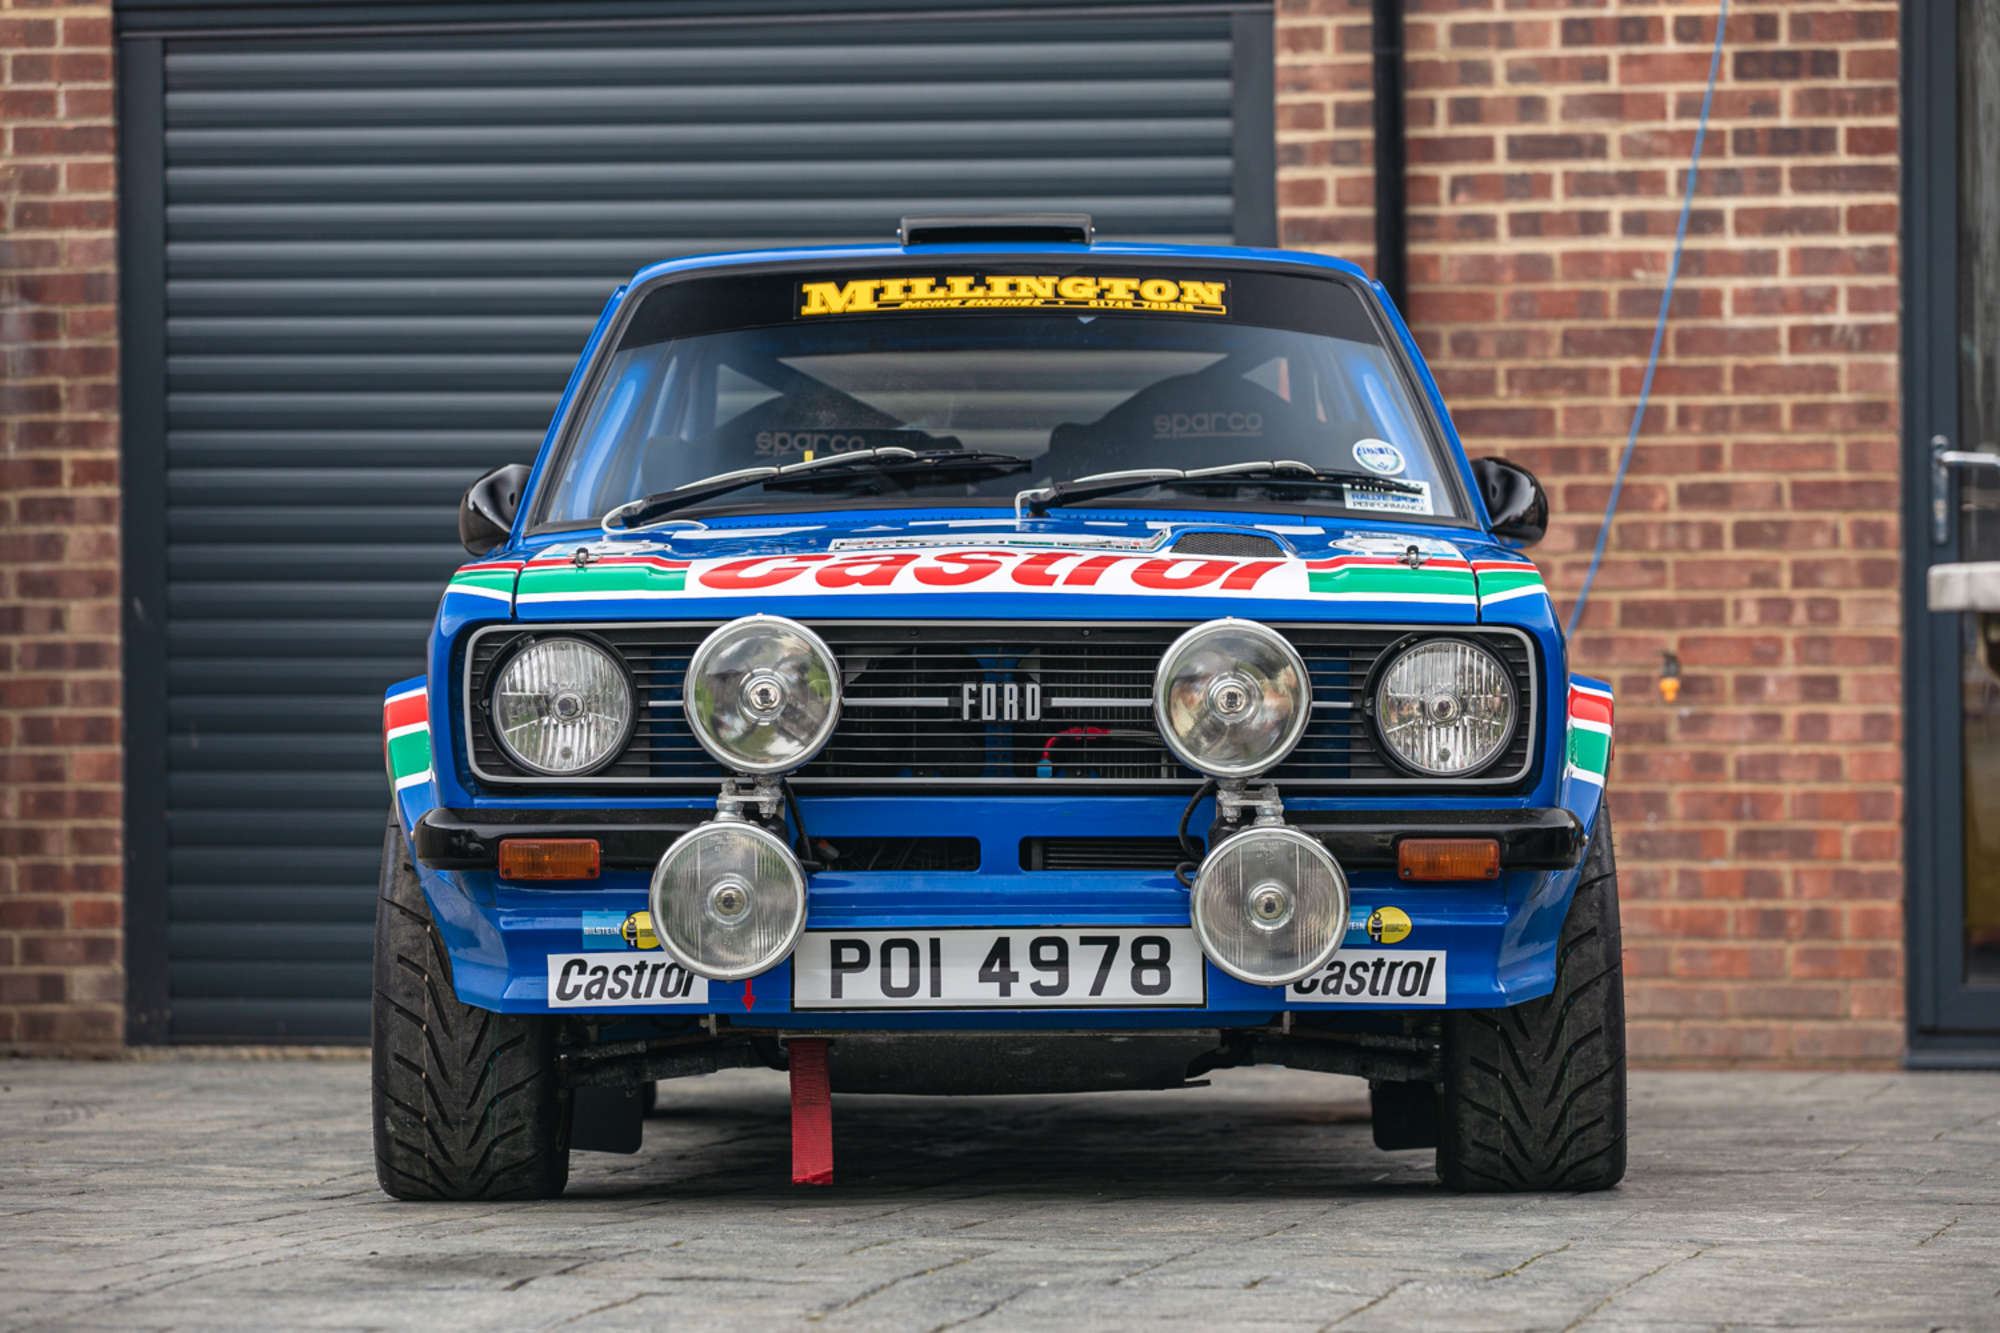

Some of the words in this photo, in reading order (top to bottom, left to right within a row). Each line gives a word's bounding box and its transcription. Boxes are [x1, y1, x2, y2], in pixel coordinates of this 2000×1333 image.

[802, 276, 1225, 314] MILLINGTON
[756, 430, 865, 457] sparco
[1153, 412, 1264, 441] sparco
[962, 683, 1041, 721] FORD
[583, 925, 621, 935] BILSTEIN
[555, 958, 696, 1001] Castrol
[830, 937, 941, 999] POI
[978, 935, 1171, 998] 4978
